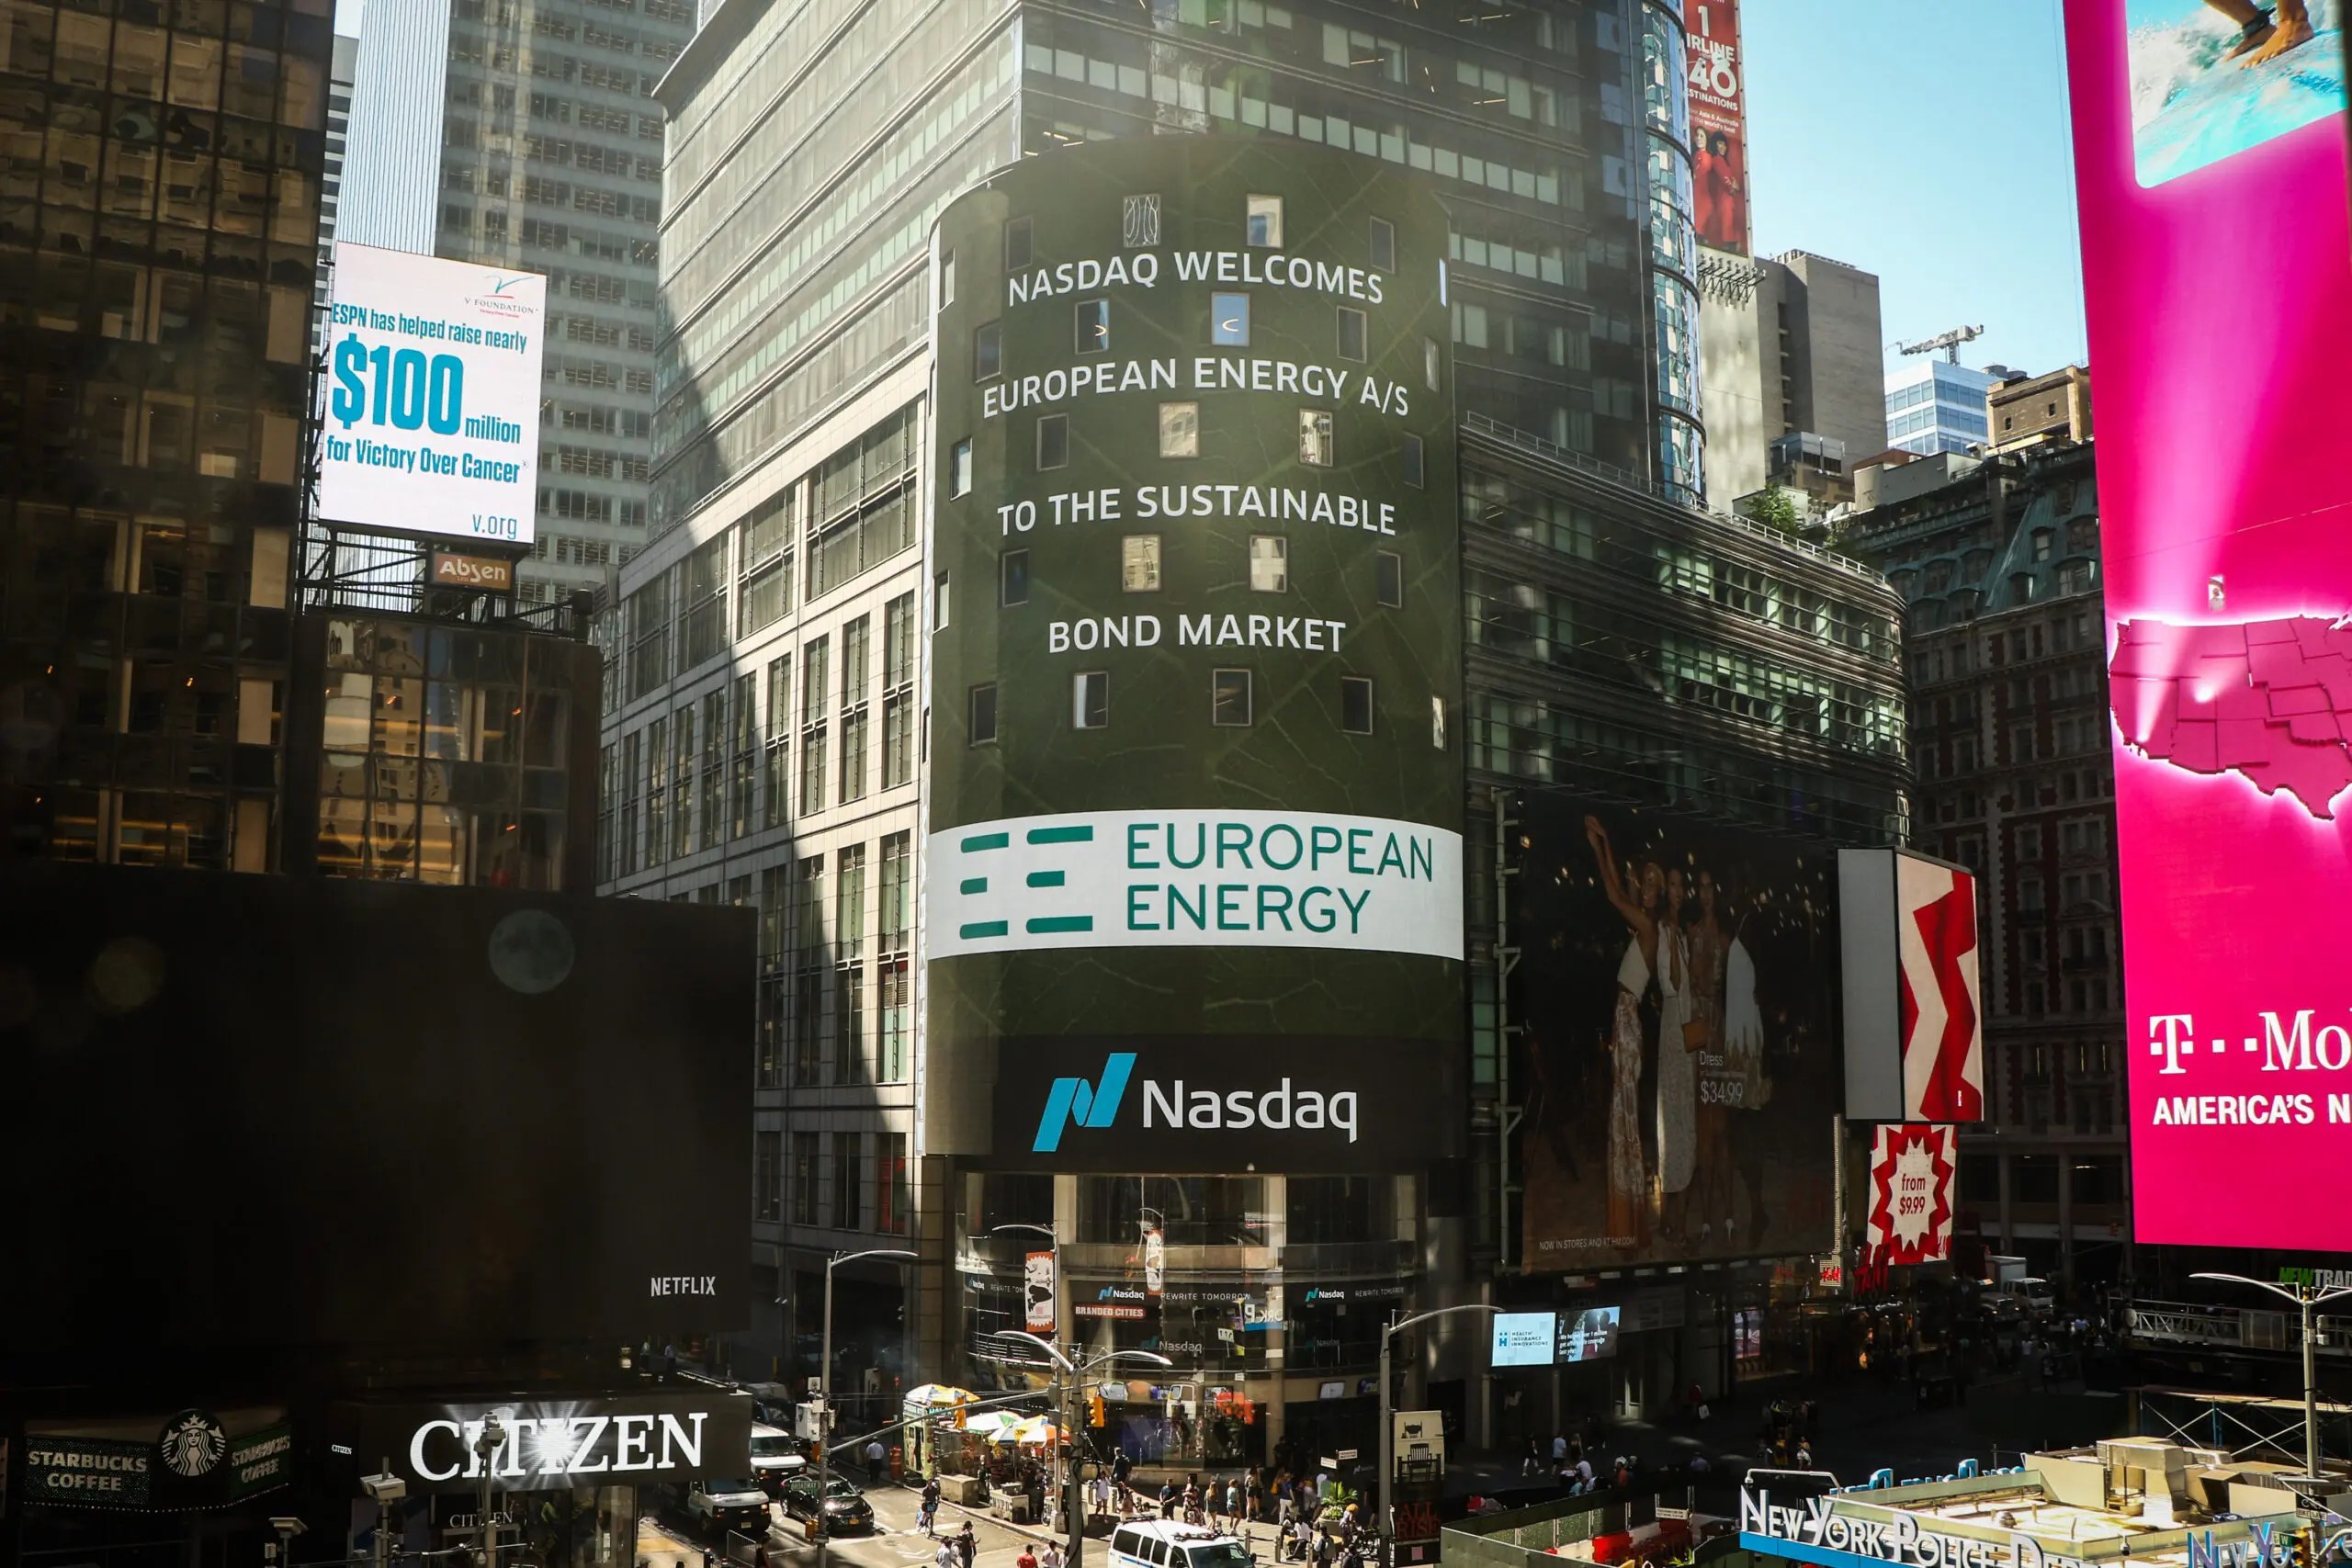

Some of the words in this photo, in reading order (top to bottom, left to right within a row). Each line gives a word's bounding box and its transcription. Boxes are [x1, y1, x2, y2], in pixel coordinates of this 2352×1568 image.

[1687, 33, 1735, 62] IRLINE
[1689, 88, 1737, 111] STINATIONS
[1009, 254, 1158, 307] NASDAQ
[1175, 252, 1383, 304] WELCOMES
[333, 302, 367, 328] ESPN
[370, 309, 395, 332] has
[399, 316, 445, 342] helped
[448, 324, 481, 345] raise
[485, 331, 527, 354] nearly
[332, 333, 463, 435] $100
[465, 415, 521, 444] million
[983, 358, 1176, 419] EUROPEAN
[1195, 357, 1348, 400] ENERGY
[1360, 376, 1408, 416] A/S
[327, 435, 350, 460] for
[356, 439, 415, 474] Victory
[421, 447, 458, 475] Over
[998, 500, 1035, 536] TO
[1049, 488, 1120, 525] THE
[1137, 485, 1396, 536] SUSTAINABLE
[440, 558, 505, 582] Absen
[1049, 615, 1160, 654] BOND
[1179, 614, 1346, 652] MARKET
[1127, 823, 1432, 882] EUROPEAN
[1127, 884, 1371, 934] ENERGY
[1700, 1051, 1724, 1066] Dress
[1701, 1079, 1743, 1105] $34.99
[1143, 1077, 1357, 1144] Nasdaq
[2153, 1093, 2314, 1125] AMERICA'S
[2328, 1093, 2352, 1124] N
[1902, 1173, 1925, 1190] from
[1899, 1196, 1925, 1216] $9.99
[1539, 1241, 1555, 1250] NOW
[1555, 1240, 1562, 1249] IN
[1564, 1239, 1587, 1249] STORES
[1589, 1238, 1601, 1247] AND
[650, 1276, 716, 1297] NETFLIX
[1114, 1289, 1145, 1301] Nasdaq
[1160, 1292, 1197, 1301] REWRITE
[1202, 1292, 1250, 1301] TOMORROW
[1318, 1290, 1345, 1300] Nasdaq
[1075, 1306, 1113, 1316] BRANDED
[1114, 1308, 1144, 1317] CITIES
[1159, 1340, 1203, 1353] Nasdaq
[232, 1435, 290, 1467] STARBUCKS
[410, 1413, 708, 1482] CITIZEN
[28, 1450, 148, 1472] STARBUCKS
[242, 1458, 279, 1483] COFFEE
[47, 1472, 121, 1491] COFFEE
[450, 1511, 514, 1529] CITEN
[1401, 1501, 1435, 1519] ALL
[1396, 1517, 1441, 1540] RISE
[1741, 1484, 1806, 1540] NEW
[1805, 1497, 1884, 1558] YORK
[1893, 1513, 1997, 1568] POLICE
